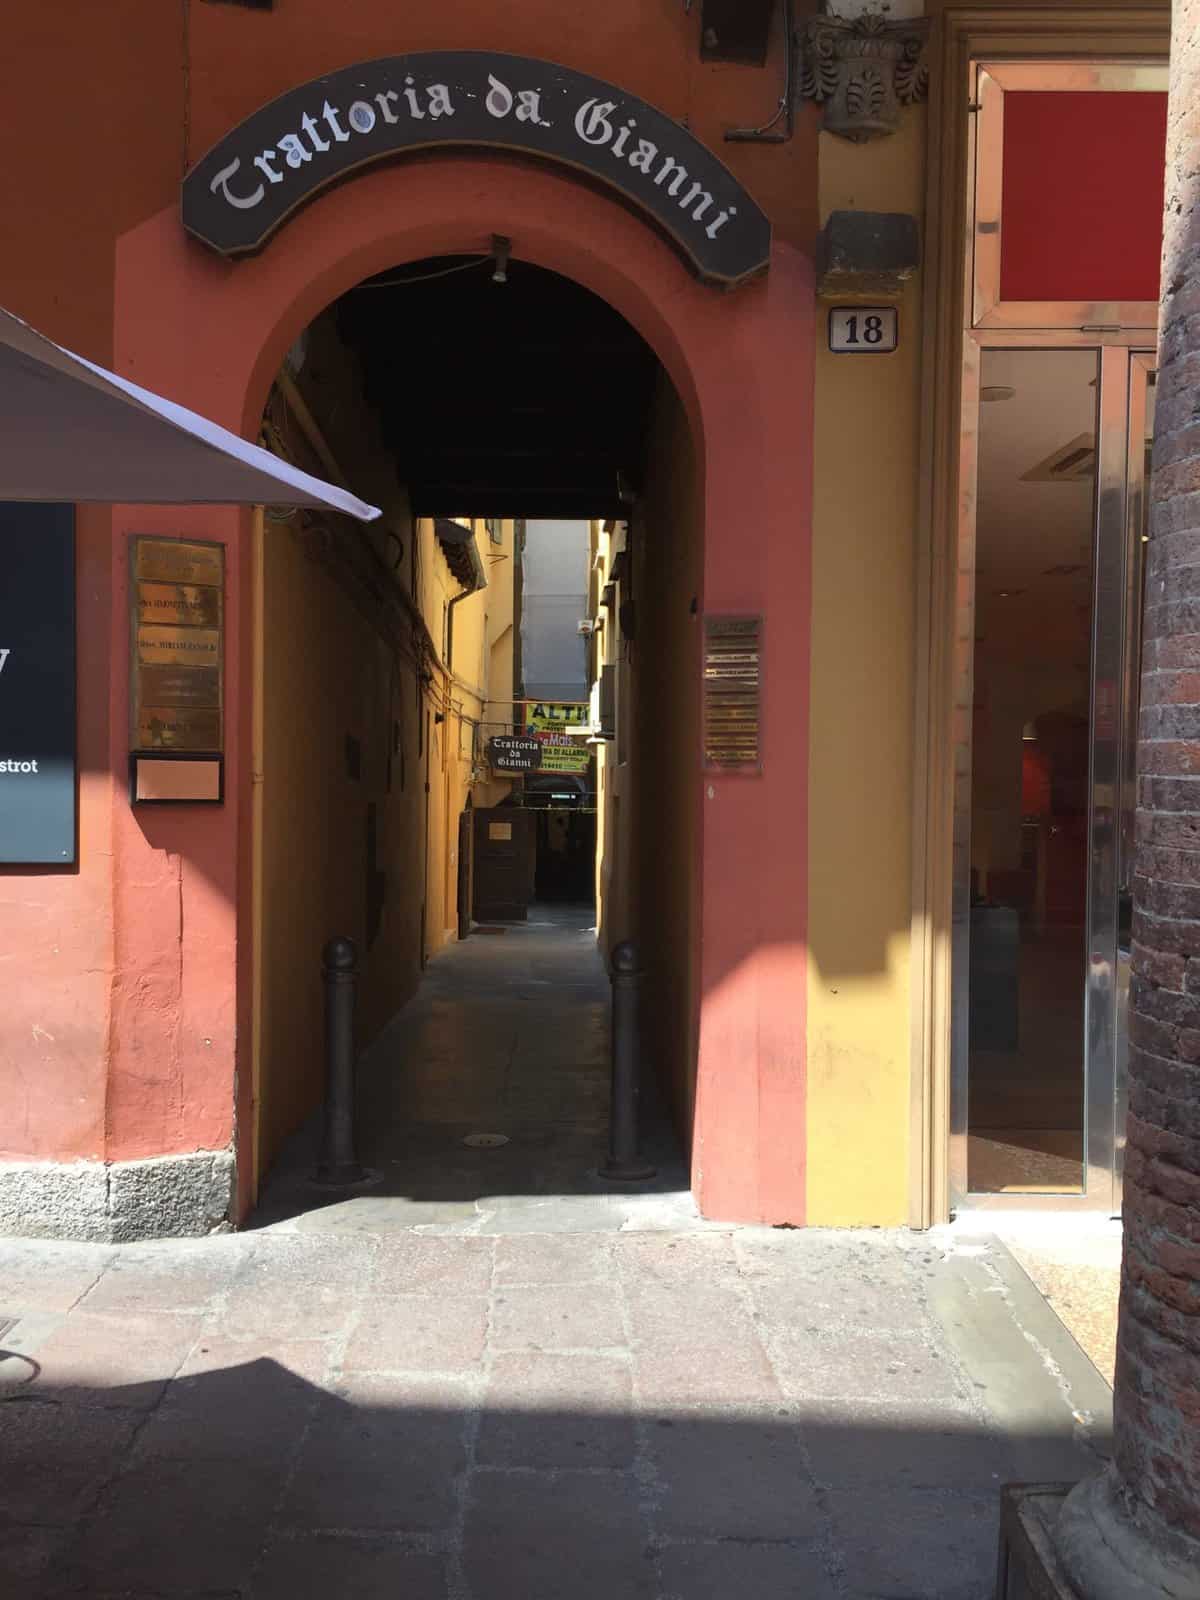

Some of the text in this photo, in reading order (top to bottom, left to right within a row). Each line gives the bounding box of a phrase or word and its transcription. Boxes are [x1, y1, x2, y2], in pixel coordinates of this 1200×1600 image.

[210, 73, 738, 240] Trattoria da Gianni
[846, 315, 882, 344] 18
[493, 738, 539, 750] Trattoria
[509, 750, 521, 758] da
[0, 759, 39, 773] strot
[497, 757, 532, 767] Gianni
